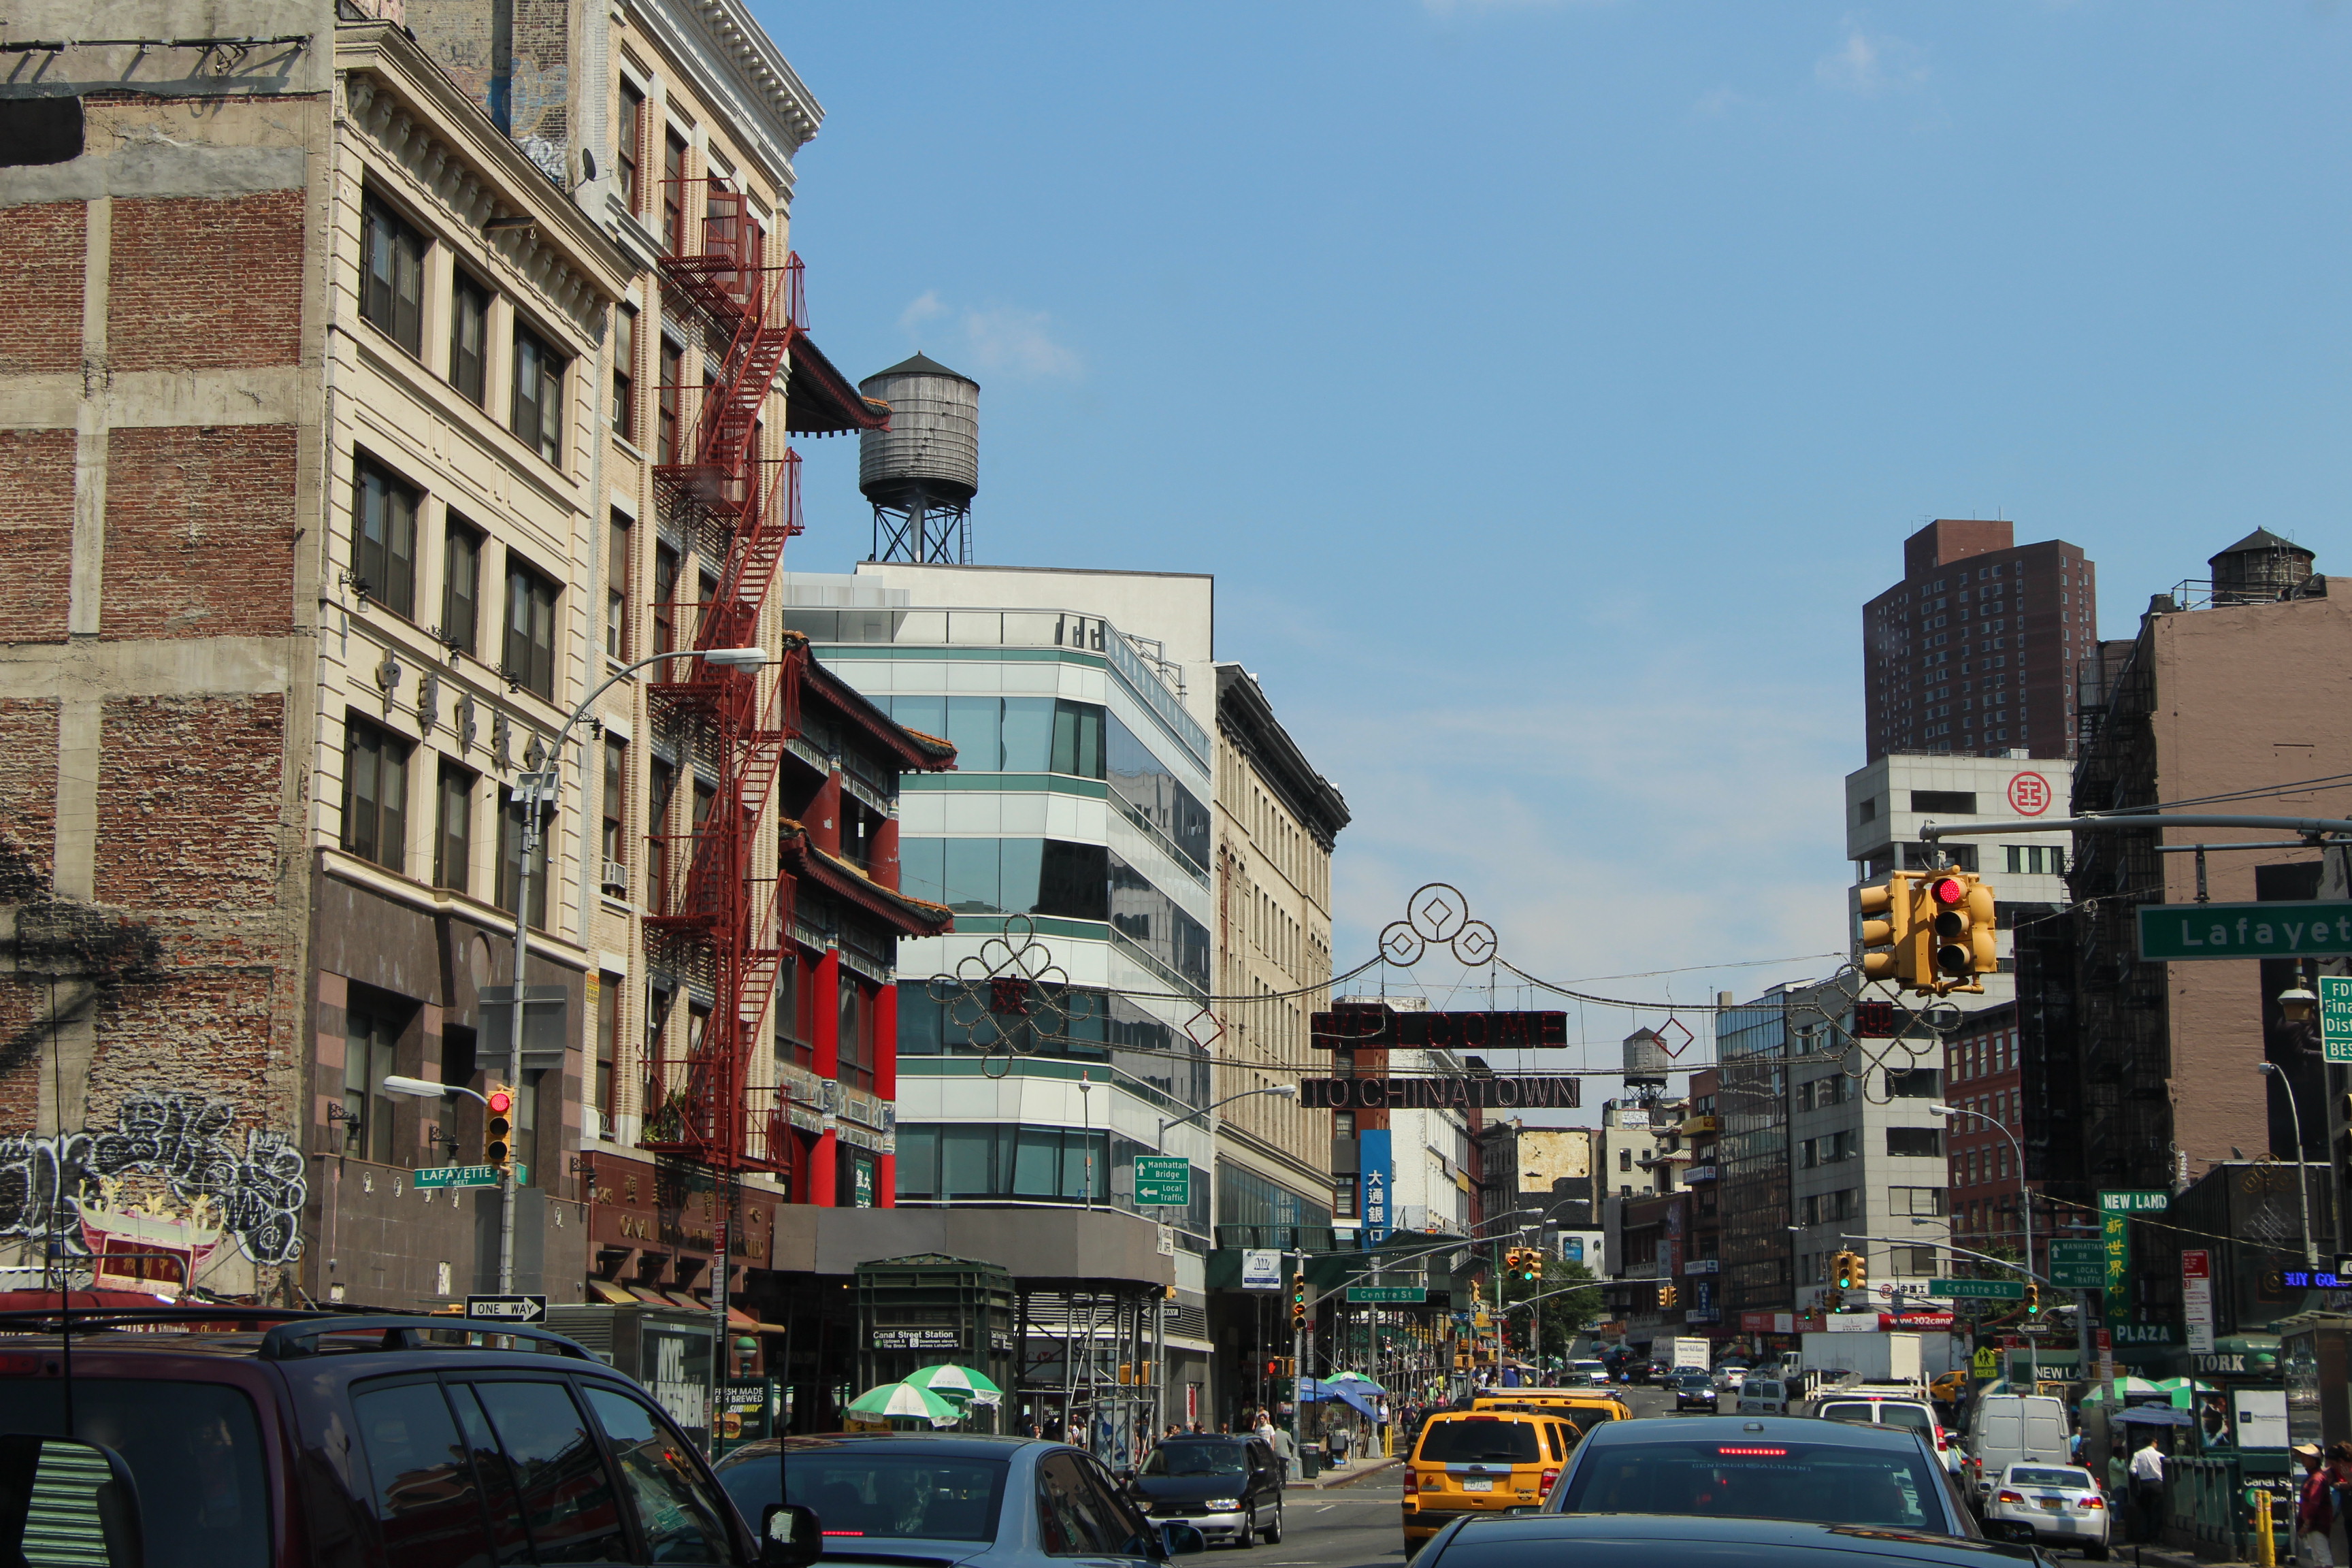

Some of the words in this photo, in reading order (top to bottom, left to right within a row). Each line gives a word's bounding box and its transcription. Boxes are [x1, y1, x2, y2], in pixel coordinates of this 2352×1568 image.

[2182, 915, 2351, 950] Lafayet
[2332, 983, 2352, 996] FD
[1311, 1011, 1567, 1048] WELCOME
[1305, 1078, 1350, 1108] TO
[1361, 1078, 1577, 1109] CHINATOWN
[1148, 1161, 1188, 1169] Manhattan
[422, 1167, 491, 1180] LAFAYETTE
[1156, 1171, 1179, 1179] Bridge
[1367, 1169, 1384, 1241] 大通銀行
[2104, 1194, 2130, 1209] NEW
[2136, 1194, 2168, 1209] LAND
[2074, 1276, 2102, 1284] TRAFFIC
[1946, 1284, 1990, 1294] Centre
[1994, 1285, 2008, 1294] St
[478, 1304, 500, 1314] ONE
[511, 1304, 534, 1314] WAY
[873, 1330, 895, 1339] Canal
[898, 1330, 921, 1339] Street
[925, 1330, 953, 1339] Station
[2117, 1325, 2171, 1341] PLAZA
[2198, 1354, 2245, 1372] YORK
[2036, 1366, 2062, 1379] NEW
[656, 1381, 705, 1428] DESIGN
[732, 1395, 764, 1403] BREWED
[728, 1404, 763, 1414] SUBWAY
[2244, 1476, 2275, 1487] Canal
